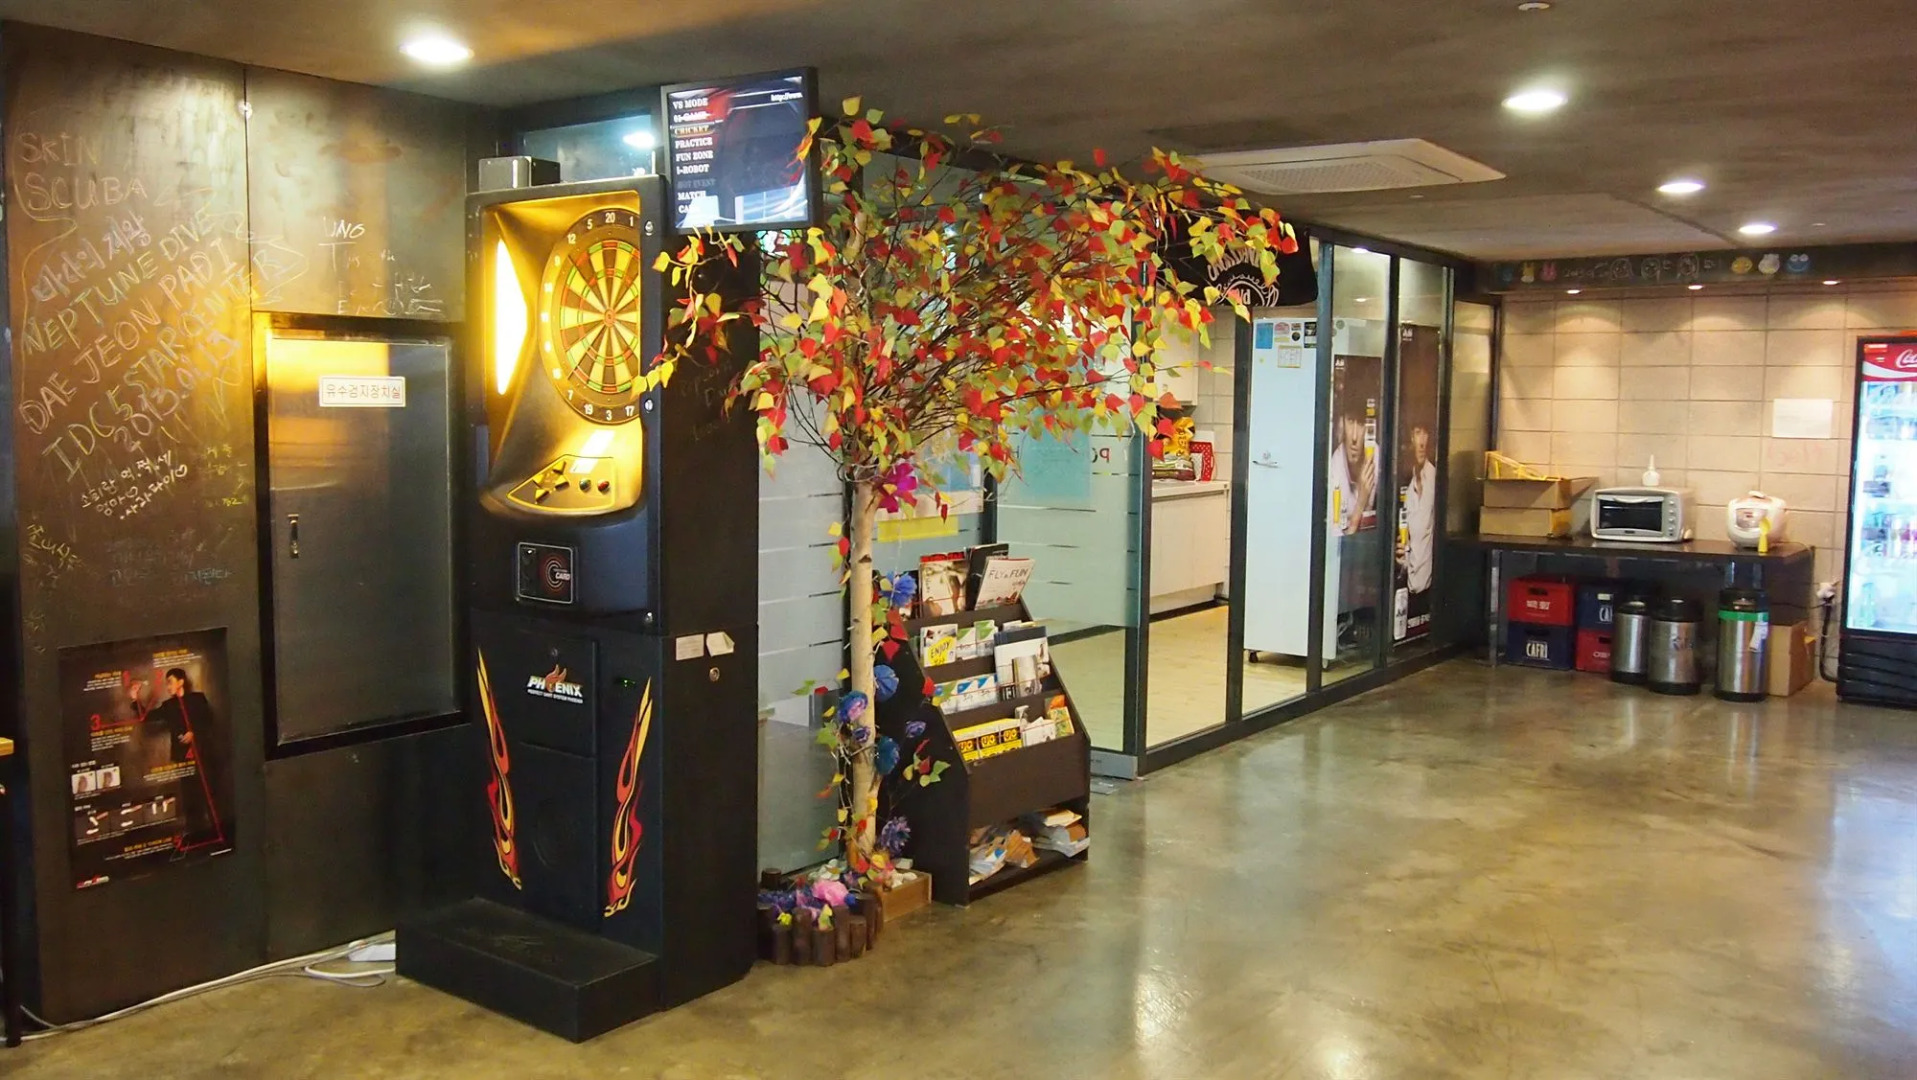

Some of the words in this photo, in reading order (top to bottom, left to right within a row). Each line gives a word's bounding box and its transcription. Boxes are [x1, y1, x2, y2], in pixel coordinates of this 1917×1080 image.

[684, 97, 709, 108] MODE
[674, 125, 709, 135] CRICKET
[675, 136, 713, 149] PRACTICE
[676, 152, 691, 162] FUN
[692, 150, 714, 160] ZONE
[24, 171, 148, 212] SCUBA
[605, 212, 616, 224] 20
[23, 250, 159, 356] NEPTUNE
[19, 372, 77, 434] DAE
[74, 298, 162, 384] JEON
[158, 237, 238, 310] PADI
[326, 384, 401, 399] 유수검지장치실
[605, 409, 613, 422] 3
